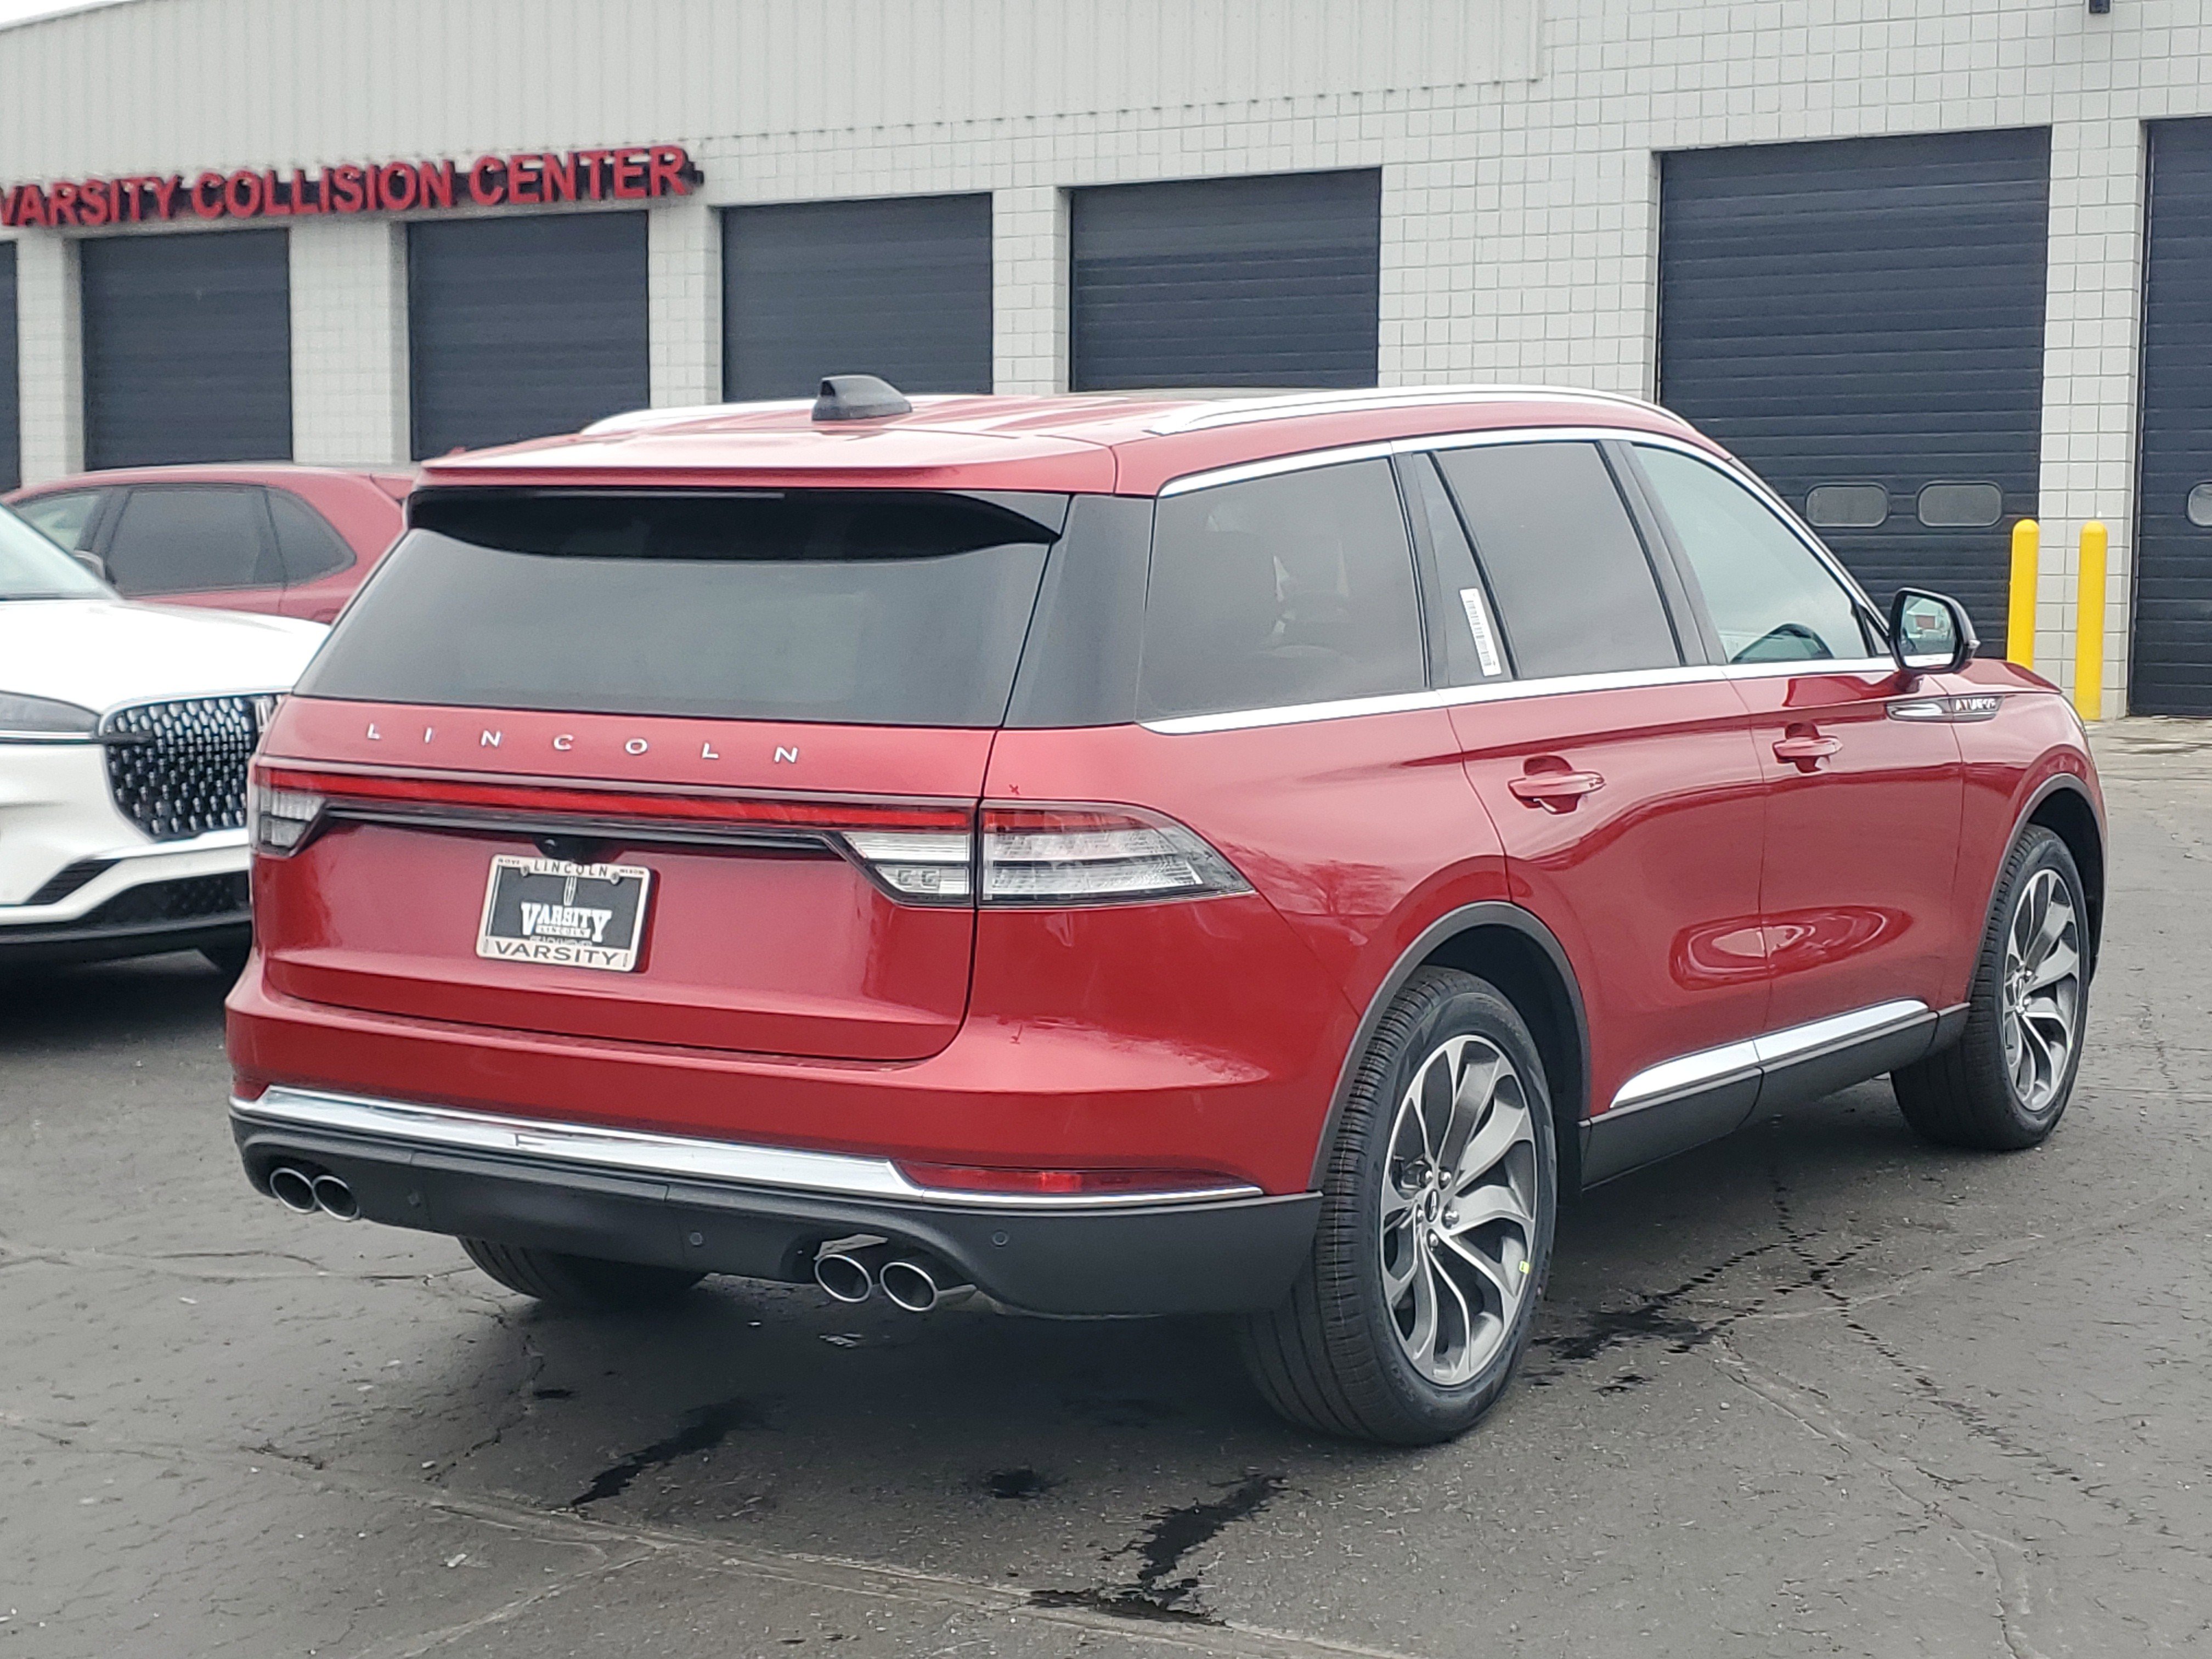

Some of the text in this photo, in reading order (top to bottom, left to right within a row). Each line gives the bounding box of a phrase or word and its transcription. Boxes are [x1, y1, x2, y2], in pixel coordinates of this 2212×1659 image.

[0, 144, 692, 226] VARSITY COLLISION CENTER
[366, 723, 799, 764] LINCOLN
[533, 859, 608, 877] LINCOLN
[520, 901, 613, 943] VARSITY
[495, 940, 619, 966] VARSITY
